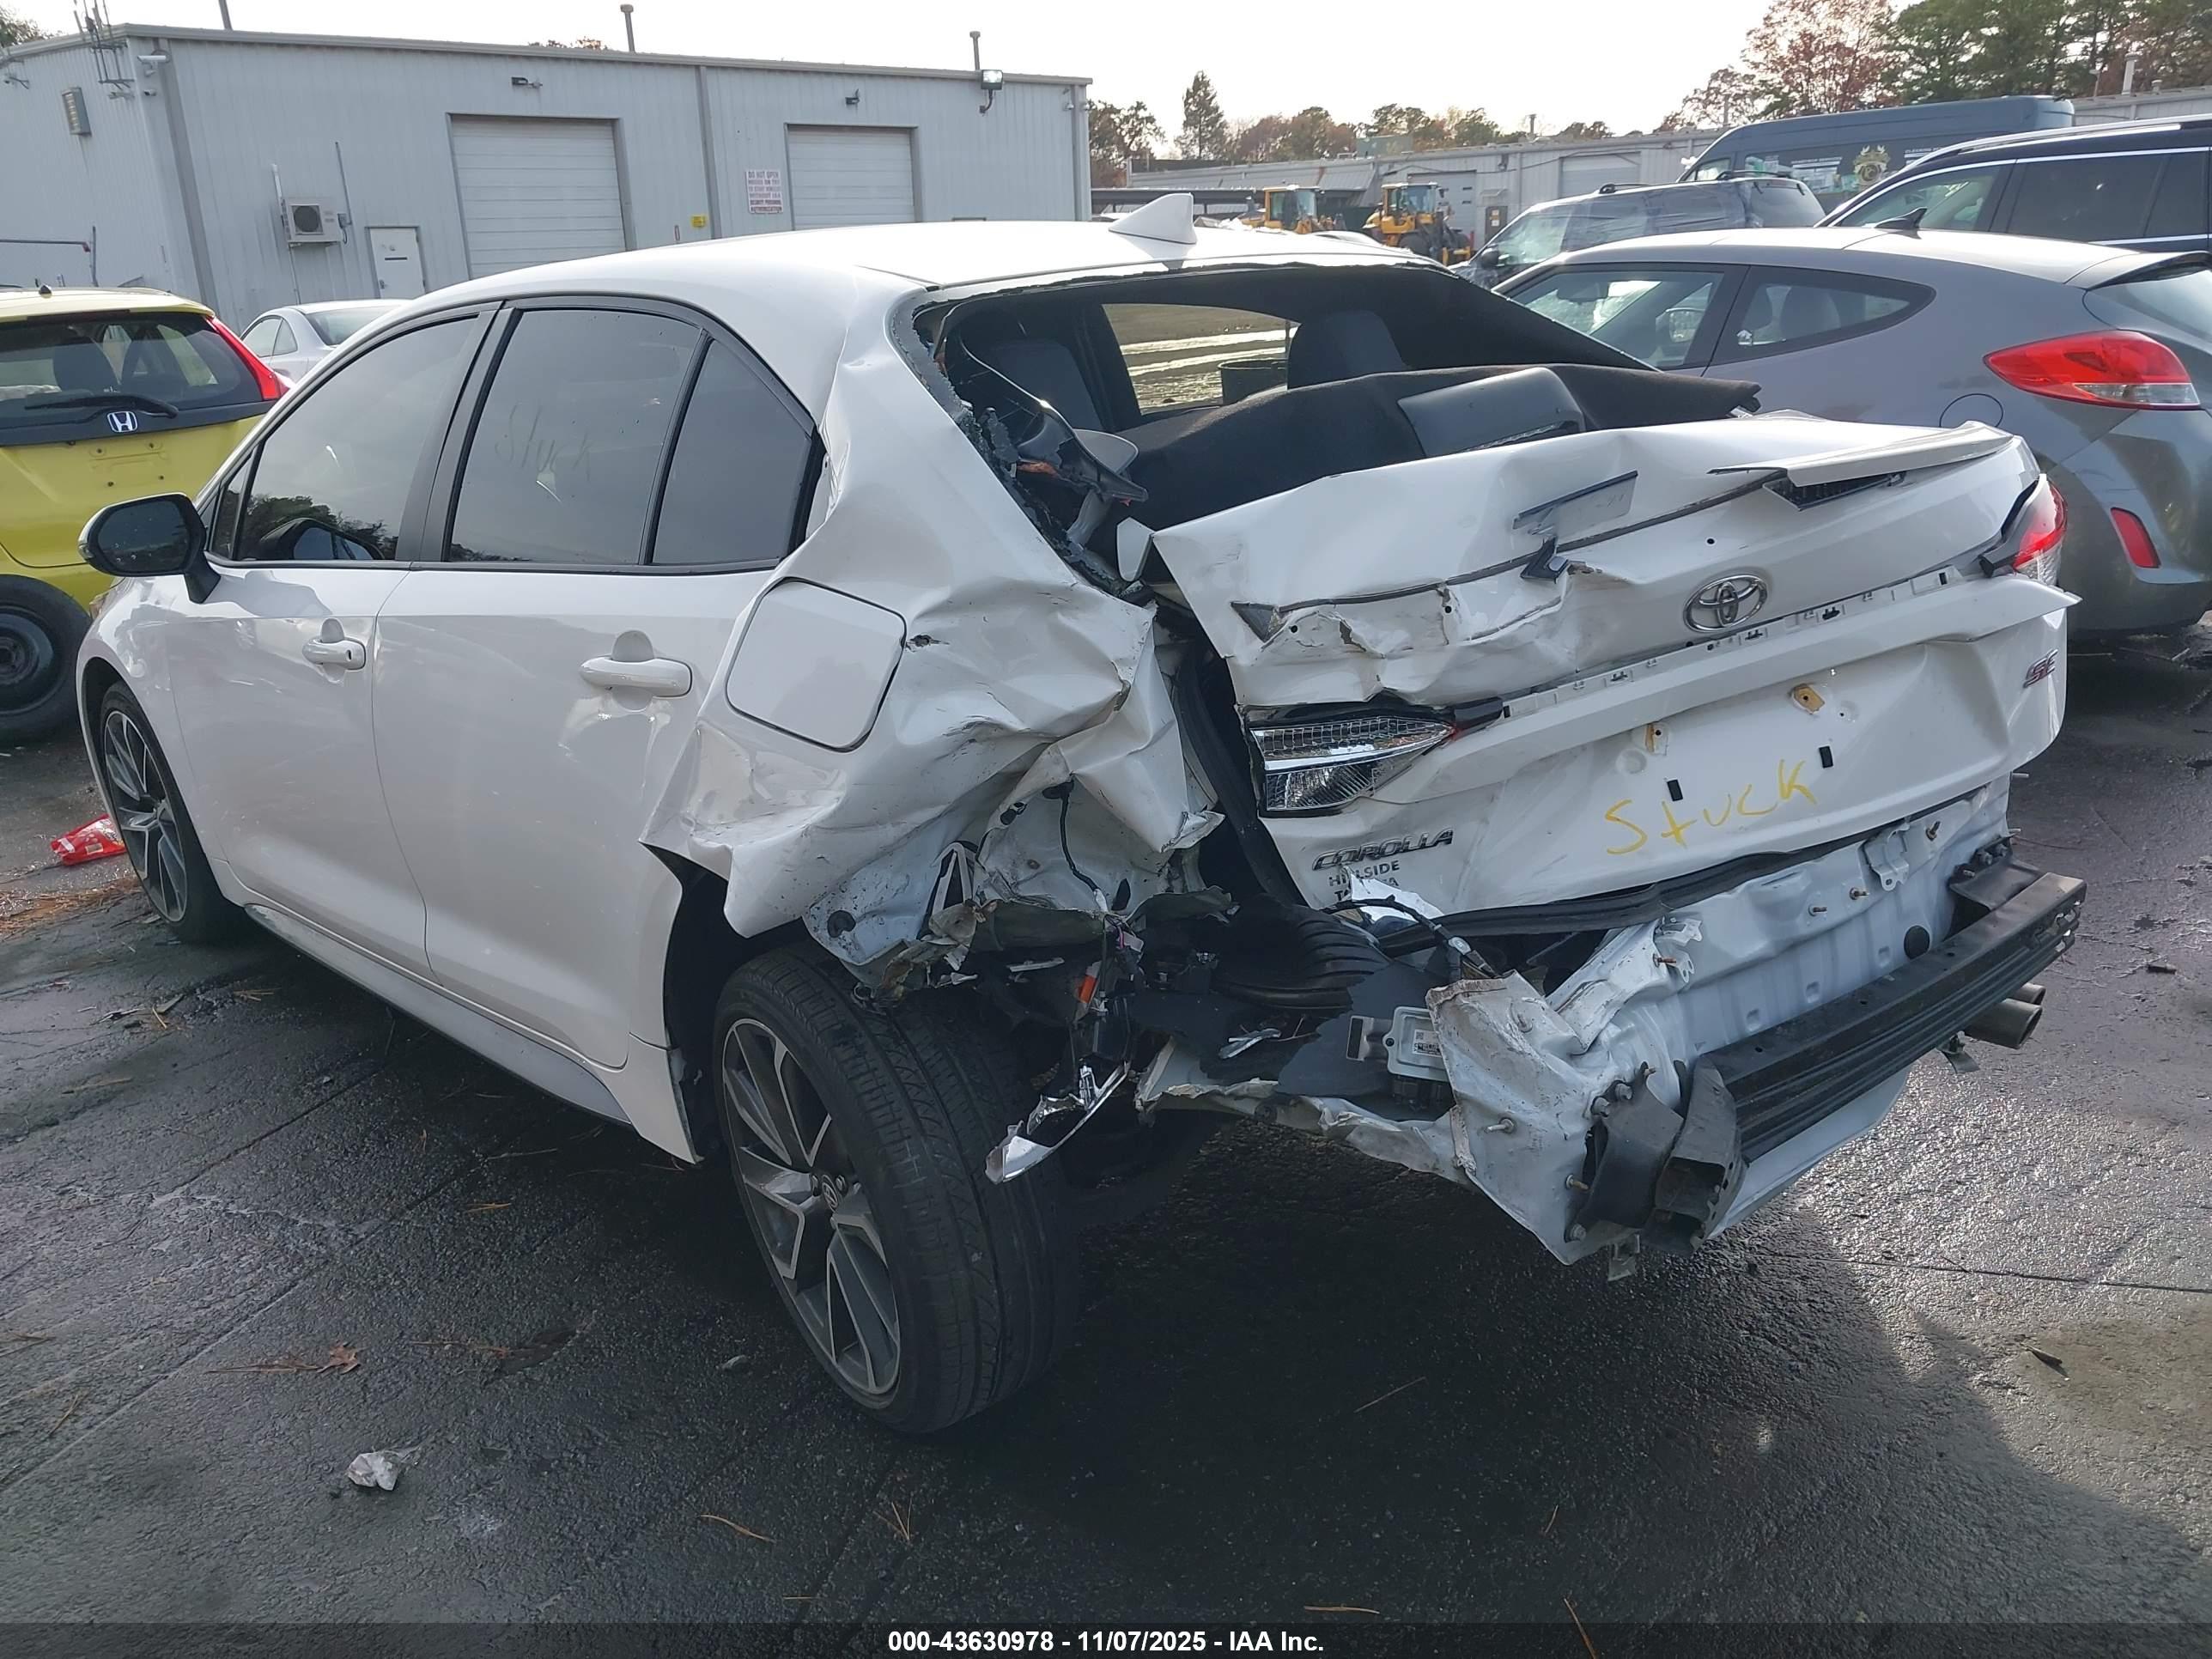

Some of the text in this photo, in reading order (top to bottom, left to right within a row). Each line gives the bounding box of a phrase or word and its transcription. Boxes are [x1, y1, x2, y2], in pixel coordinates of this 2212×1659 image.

[2024, 648, 2058, 687] SE
[1312, 828, 1454, 871] COROLLA
[1328, 860, 1401, 887] HILSIDE
